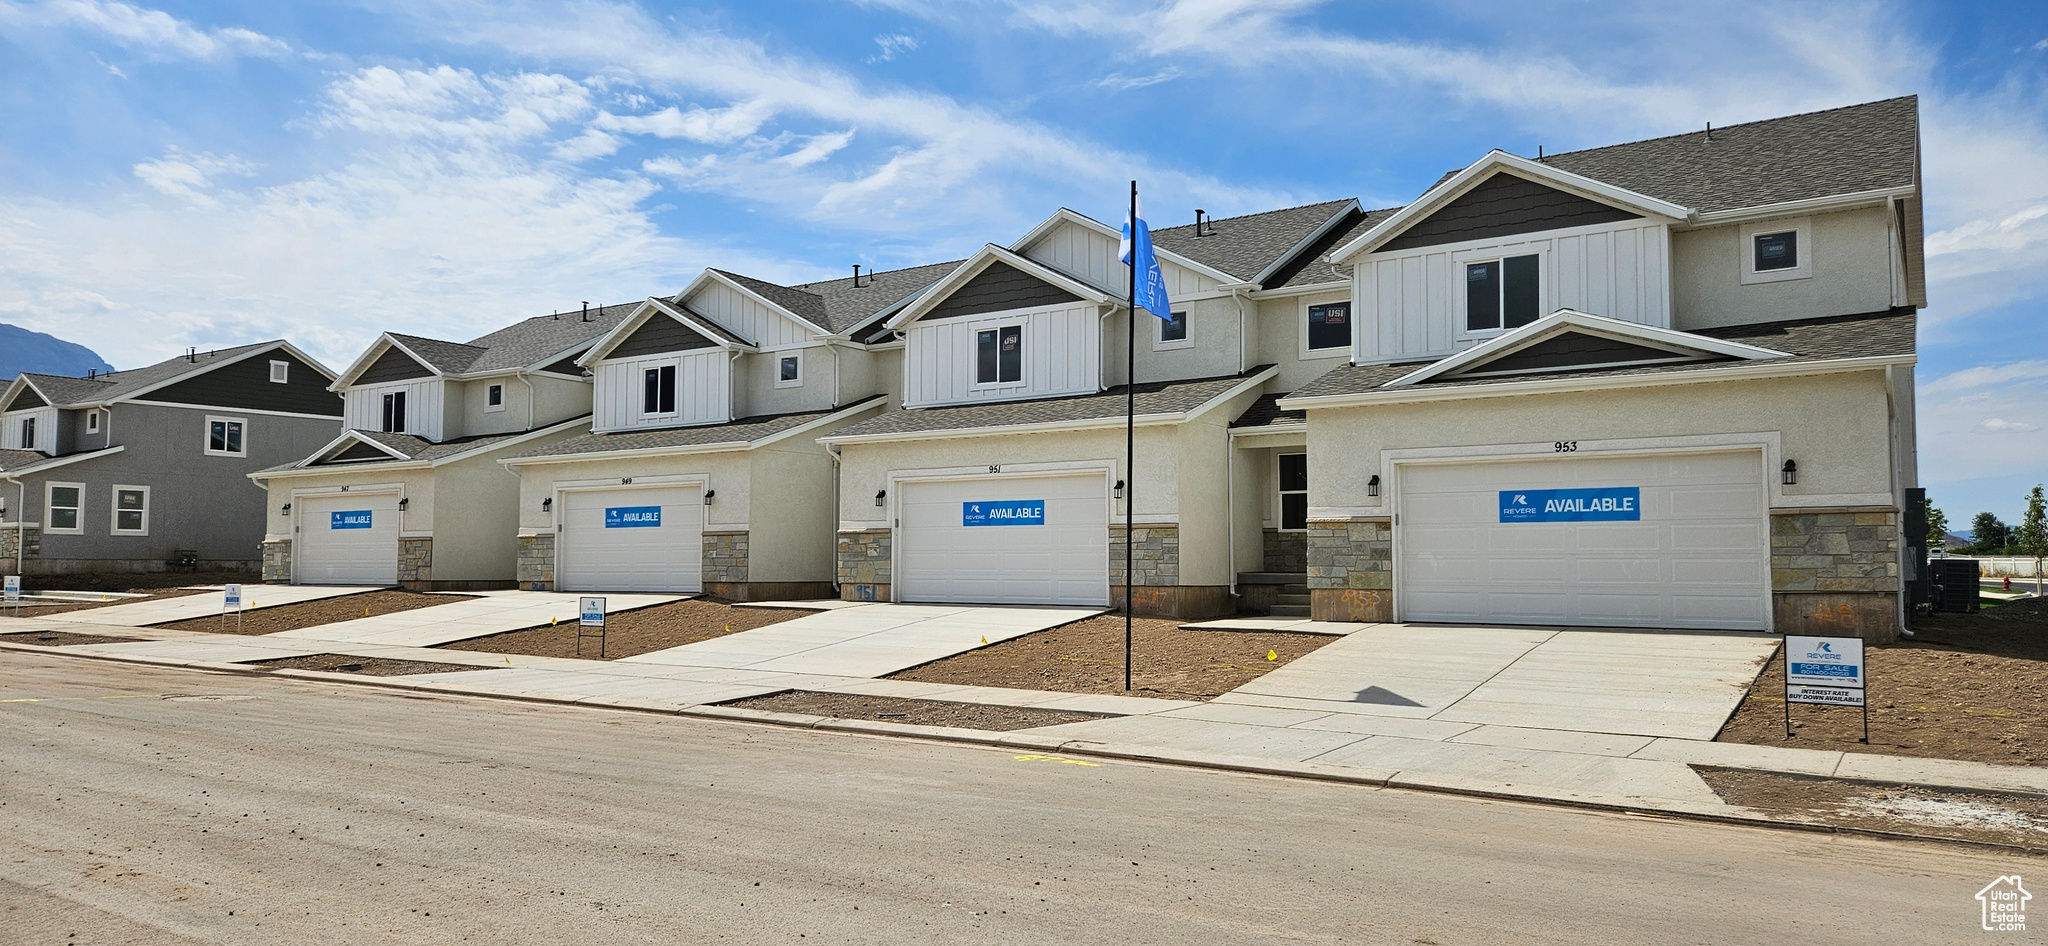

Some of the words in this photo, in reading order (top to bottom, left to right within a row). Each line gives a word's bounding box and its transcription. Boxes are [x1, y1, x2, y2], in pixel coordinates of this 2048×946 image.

[1328, 309, 1344, 318] USI
[1554, 441, 1577, 453] 953
[989, 465, 1000, 474] 951
[1544, 497, 1634, 513] AVAILABLE
[989, 508, 1042, 518] AVAILABLE
[1503, 507, 1537, 515] REVERE
[622, 512, 659, 522] AVAILABLE
[856, 584, 876, 600] 951
